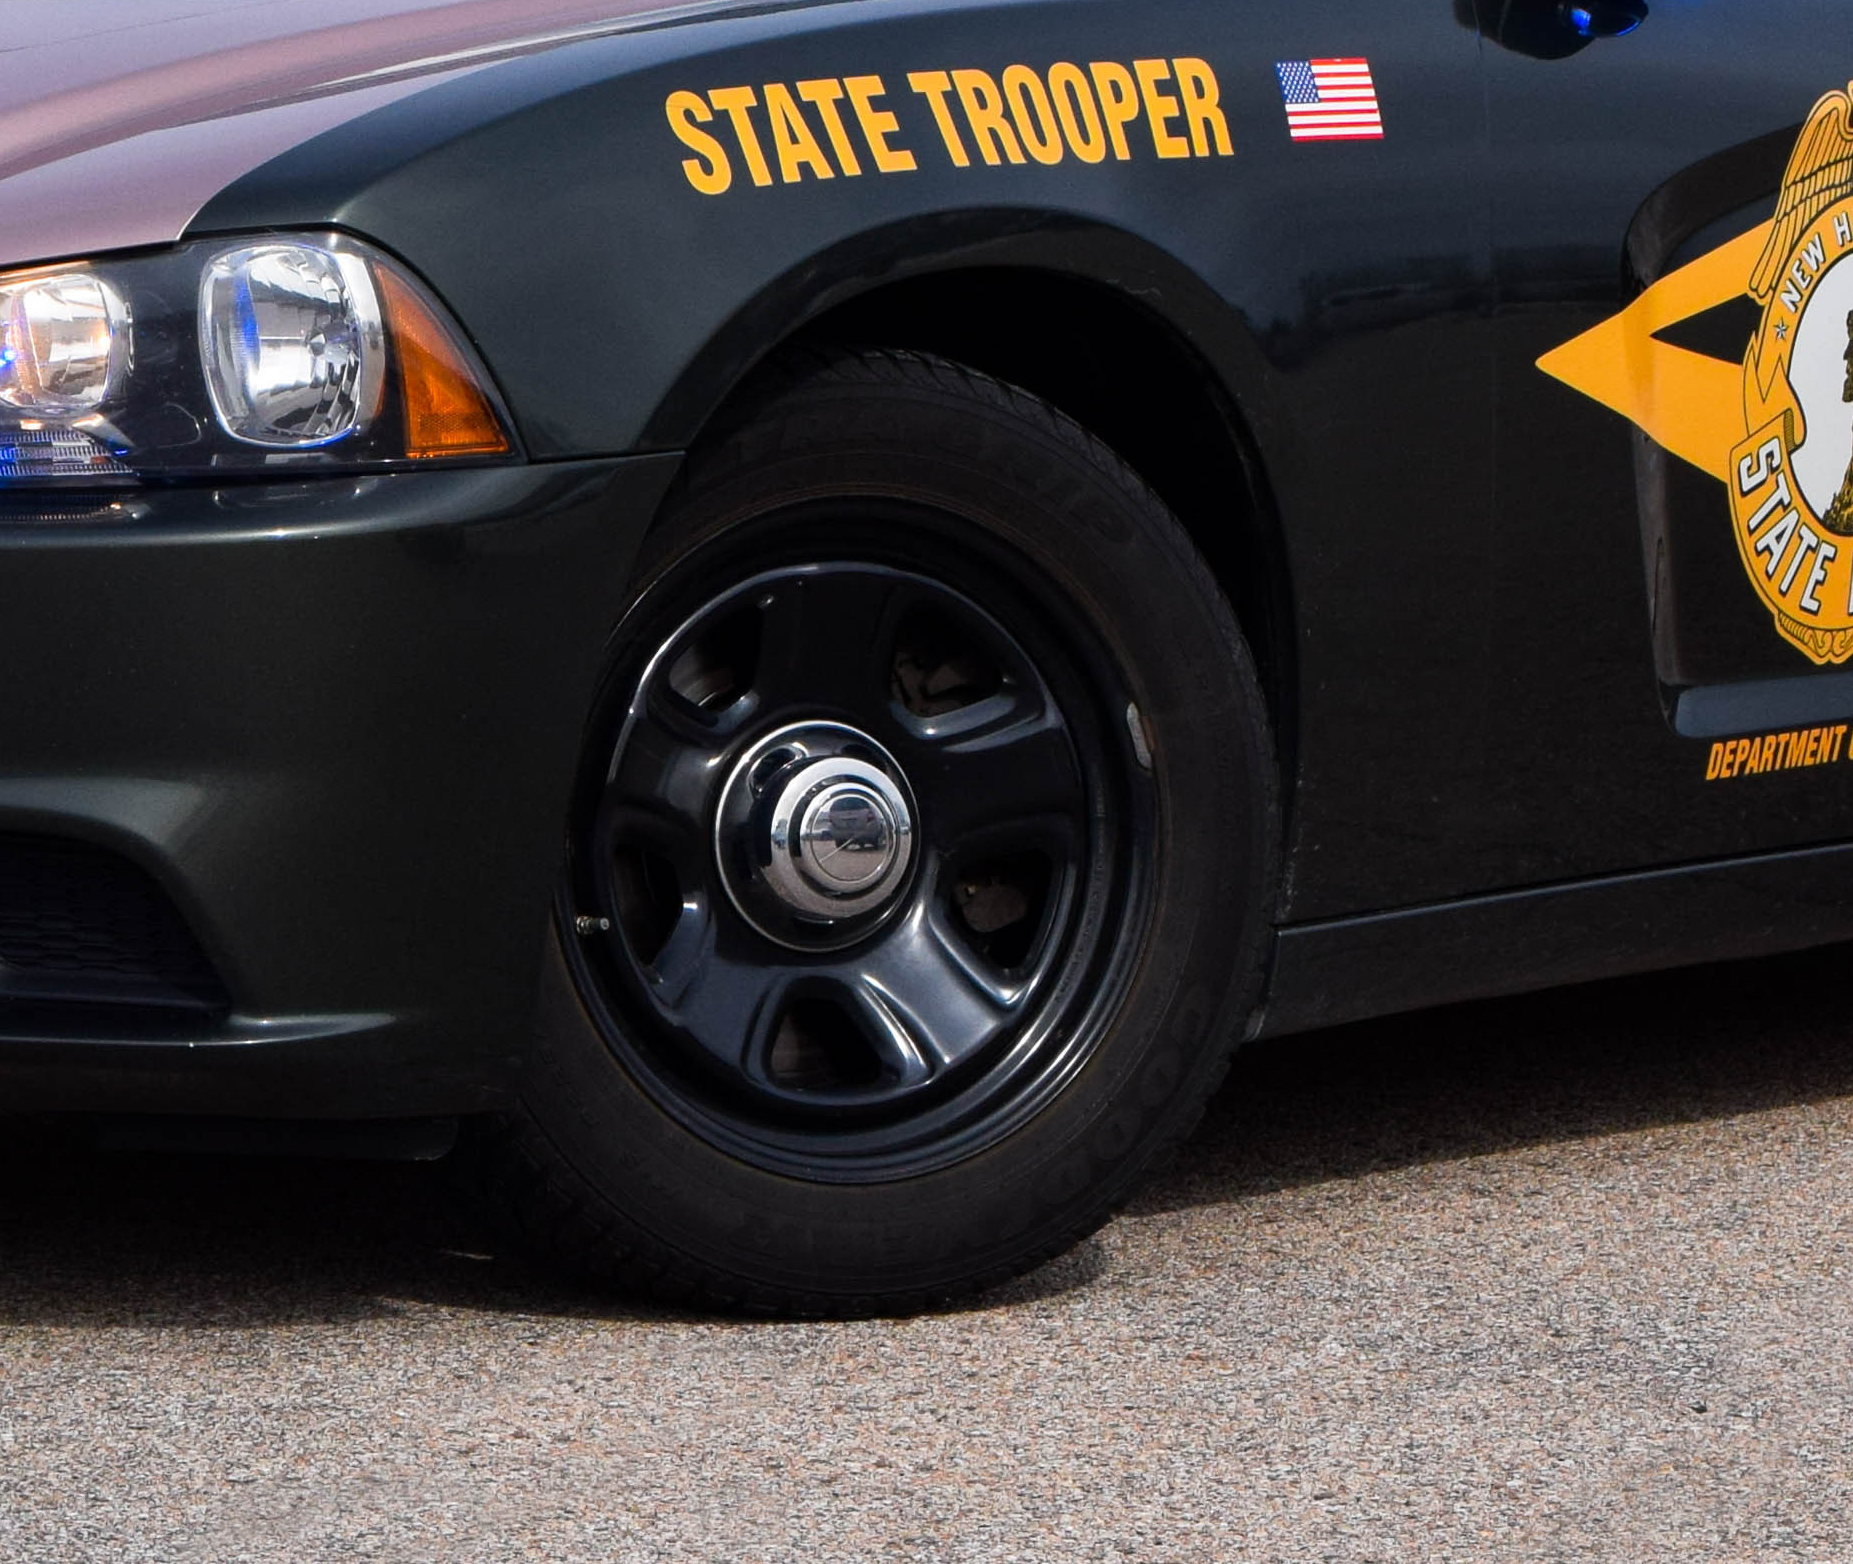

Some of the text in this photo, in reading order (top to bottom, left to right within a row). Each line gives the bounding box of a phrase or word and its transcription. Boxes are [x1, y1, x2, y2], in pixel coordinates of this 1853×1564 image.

[666, 57, 1234, 195] STATE TROOPER
[1780, 235, 1826, 312] NEW
[1738, 438, 1837, 614] STATE
[1706, 725, 1846, 780] DEPARTMENT
